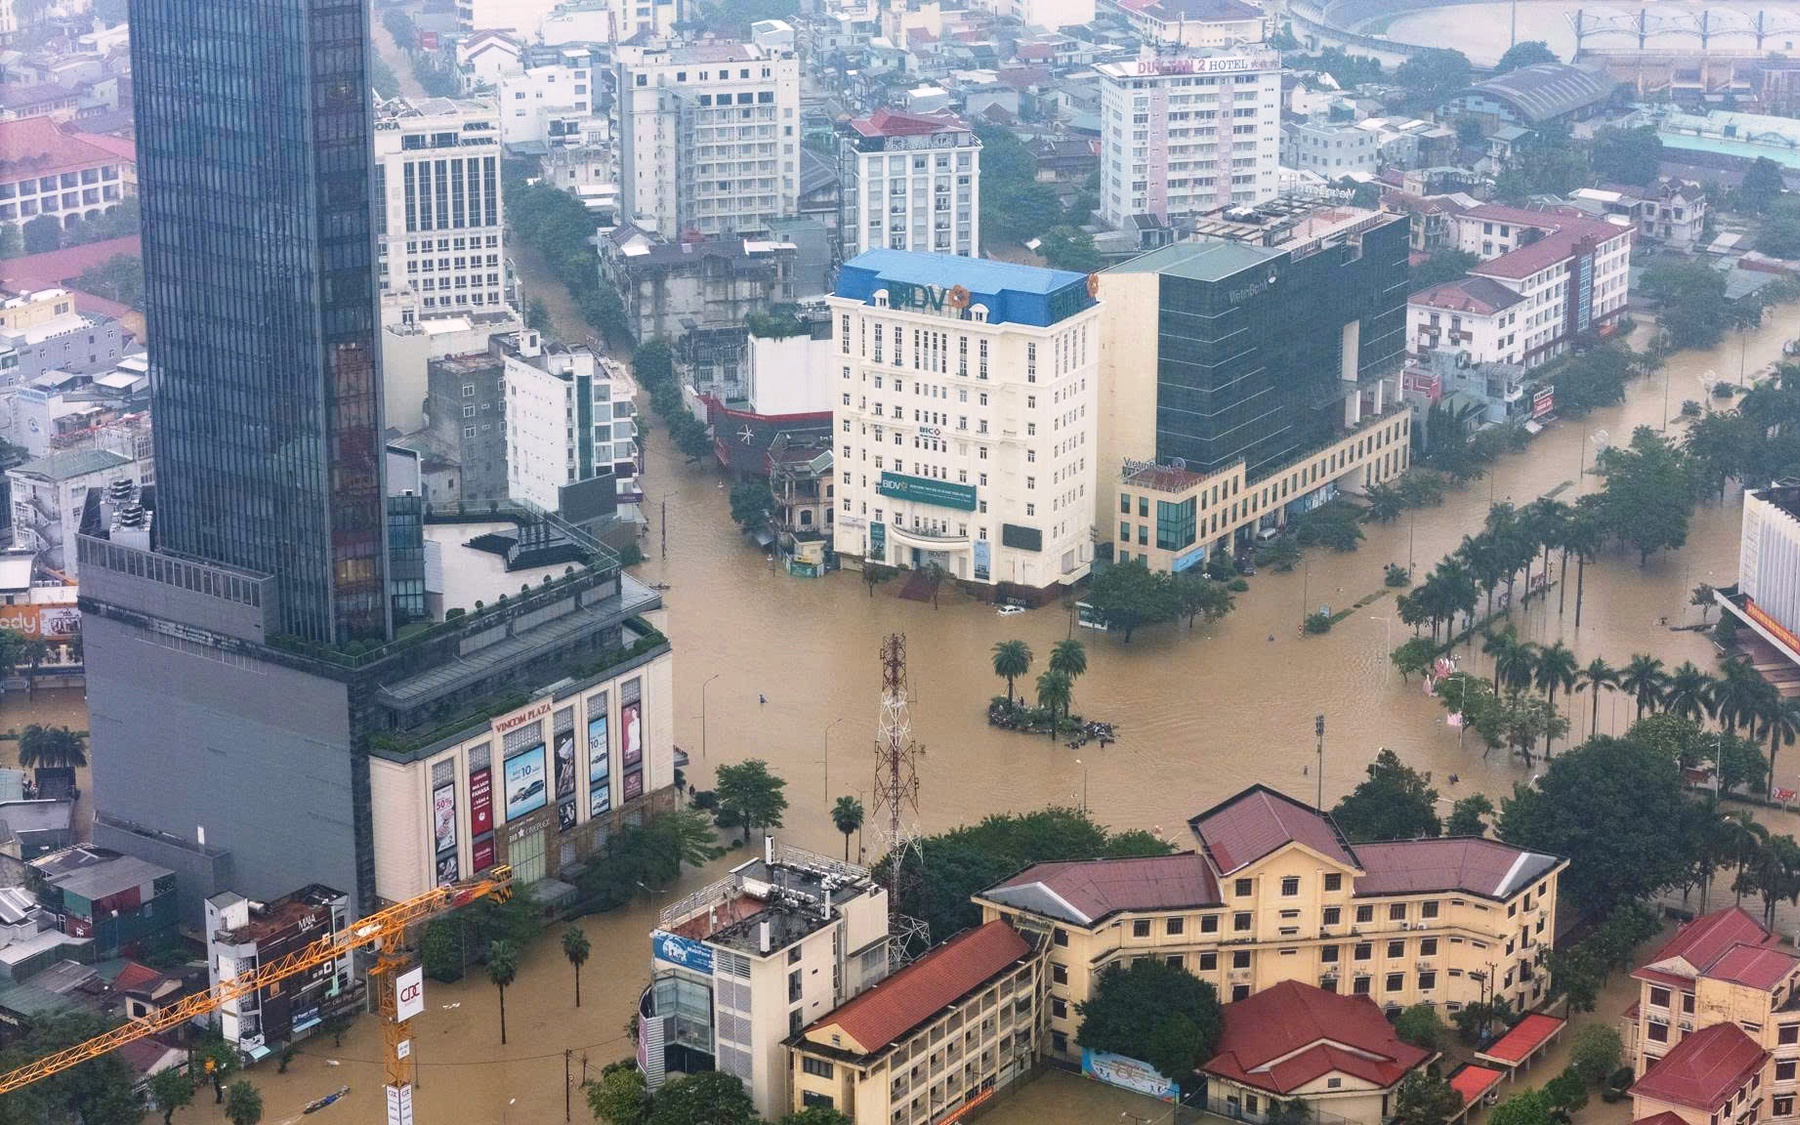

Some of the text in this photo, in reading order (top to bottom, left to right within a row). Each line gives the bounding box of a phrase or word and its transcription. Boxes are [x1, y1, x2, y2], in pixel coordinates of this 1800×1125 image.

[1198, 60, 1206, 71] 2
[1209, 59, 1248, 71] HOTEL
[882, 479, 901, 490] BIDV
[495, 703, 552, 732] VINCOM PLAZA
[590, 739, 599, 750] 10
[521, 765, 532, 777] 10
